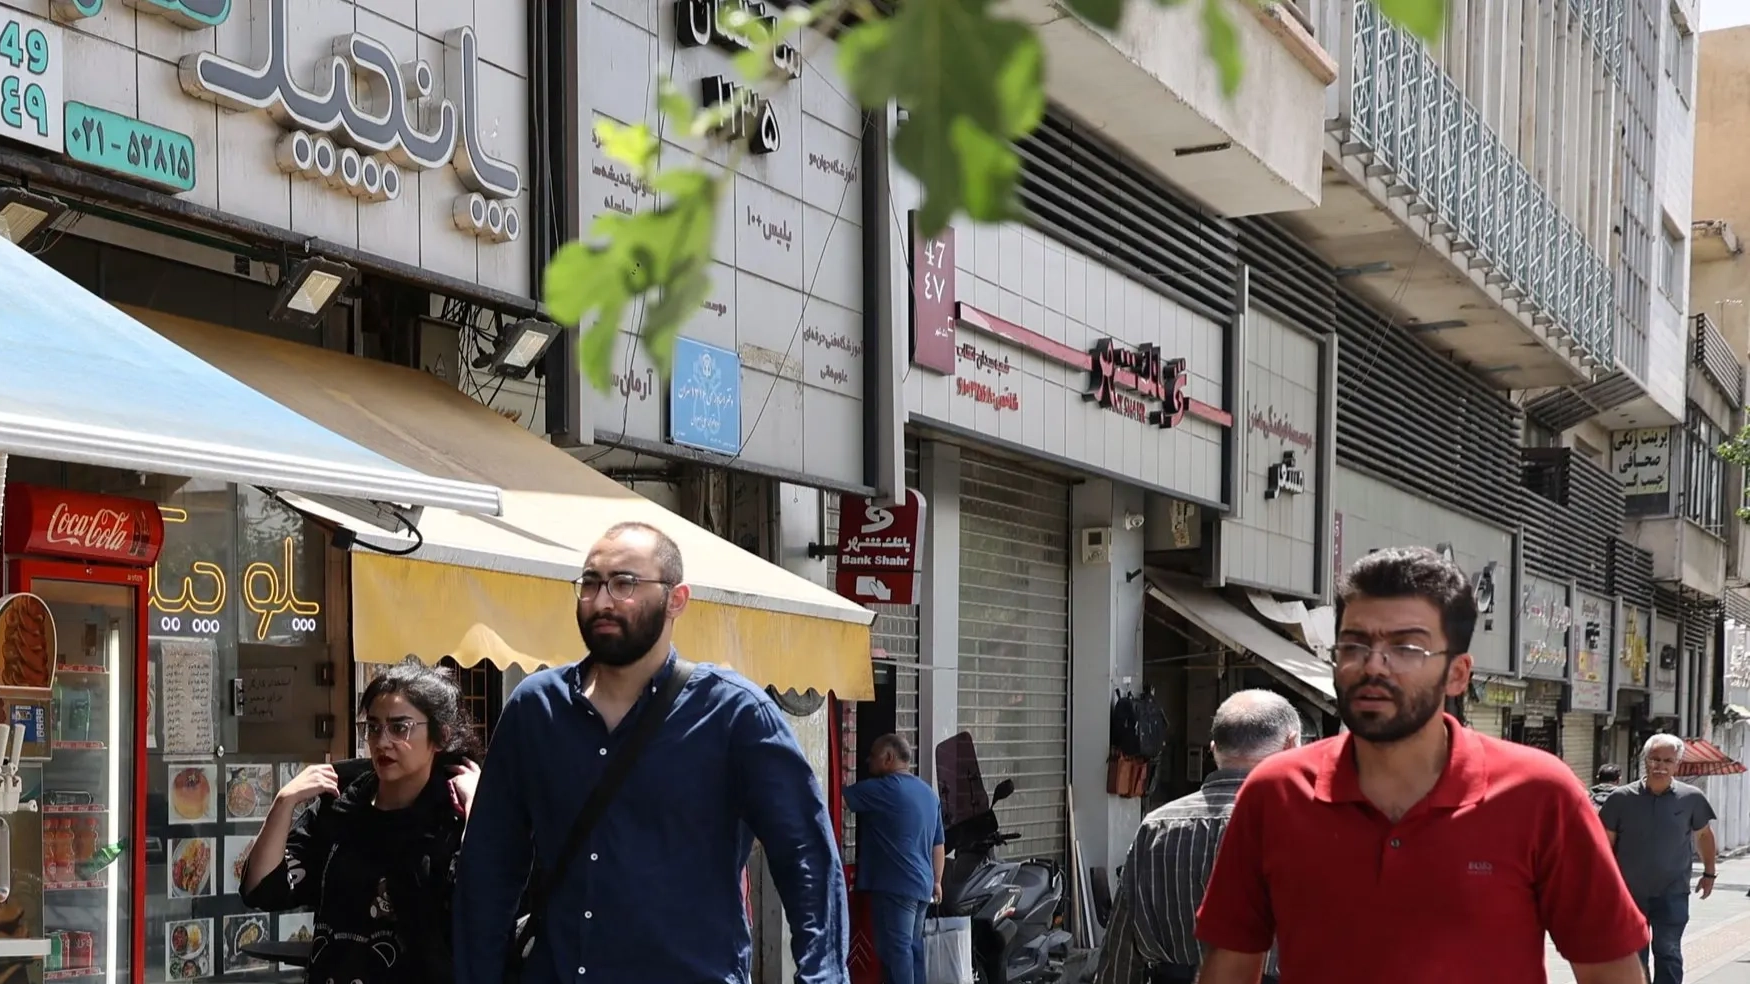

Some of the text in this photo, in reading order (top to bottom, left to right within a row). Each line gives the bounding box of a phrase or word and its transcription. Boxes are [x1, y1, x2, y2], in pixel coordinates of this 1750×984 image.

[763, 220, 792, 251] پلیس
[924, 240, 945, 269] 47
[1619, 451, 1661, 473] صحافی
[842, 555, 909, 566] Bank Shahr
